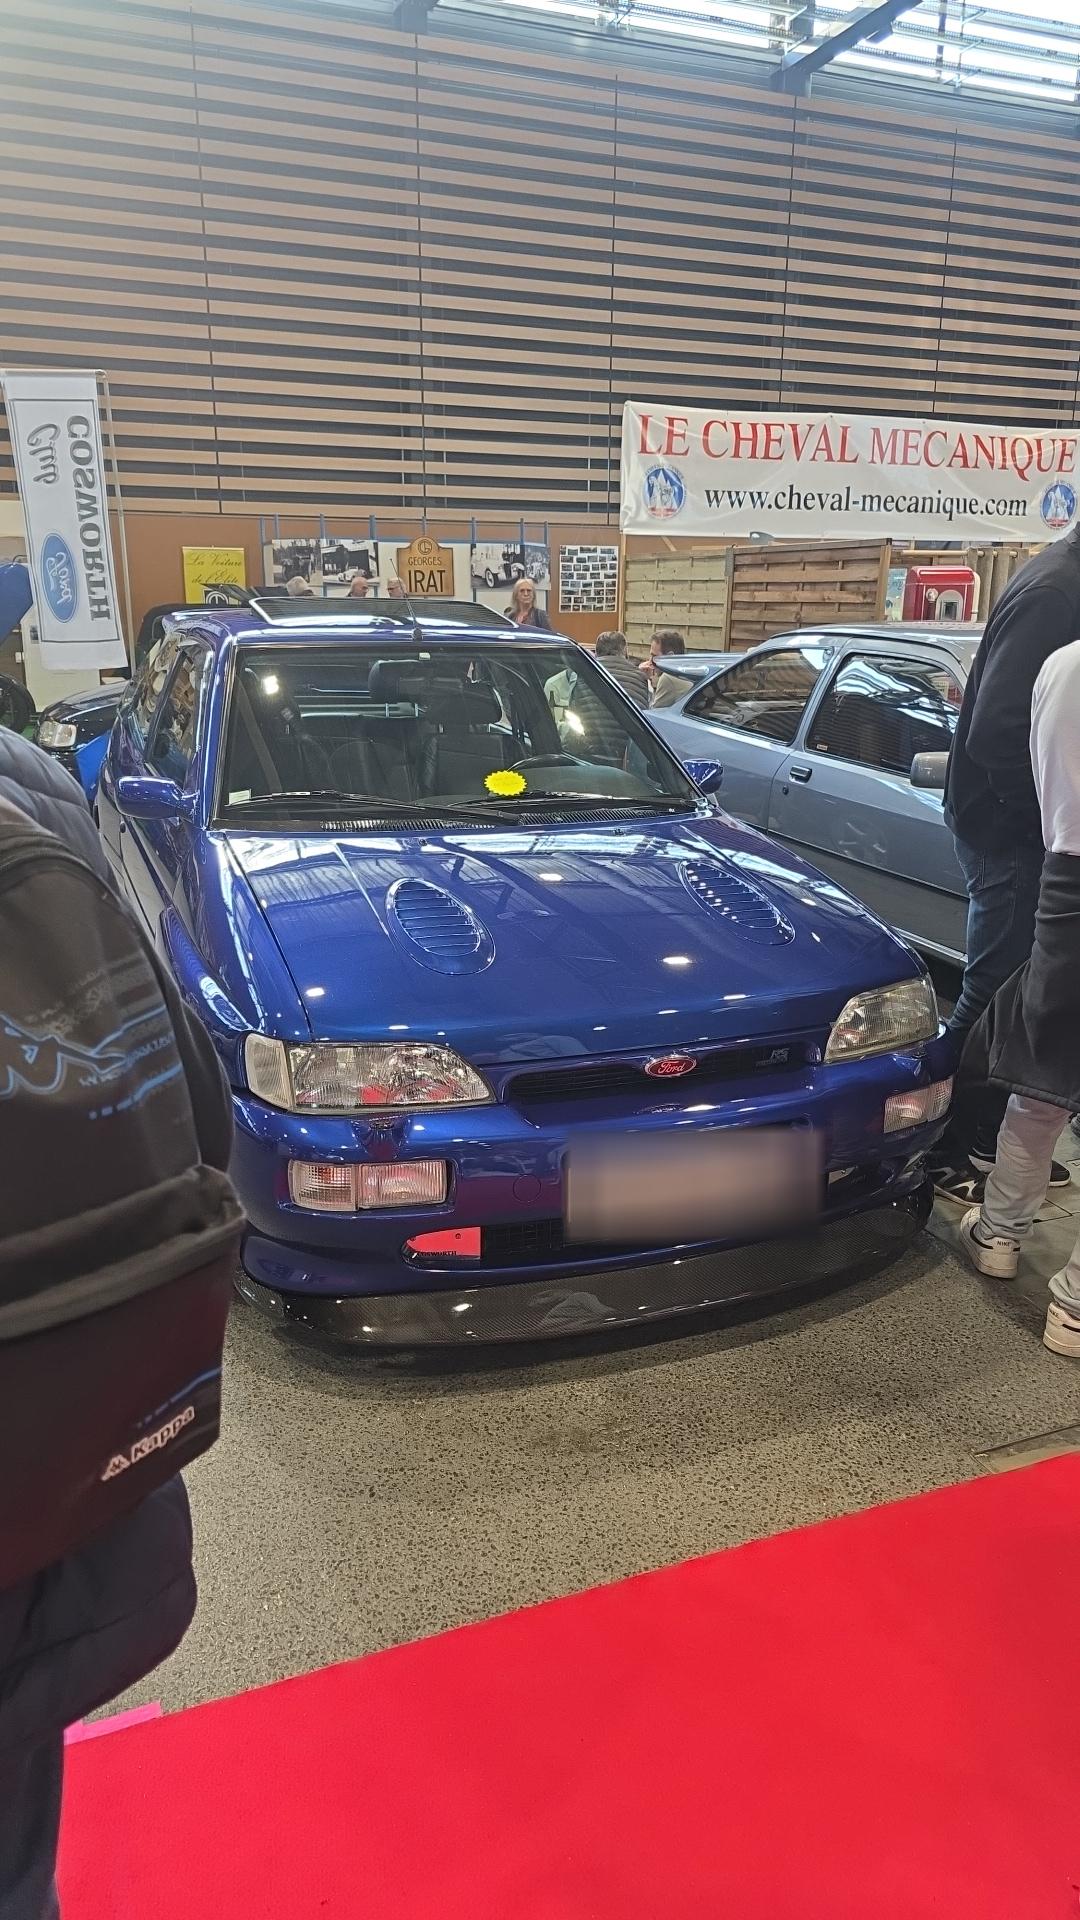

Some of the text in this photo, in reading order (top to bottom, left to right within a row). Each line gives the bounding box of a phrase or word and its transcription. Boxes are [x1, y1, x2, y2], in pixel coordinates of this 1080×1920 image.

[638, 415, 1078, 481] LE CHEVAL MECANIQUE
[704, 485, 1028, 521] www.cheval-mecanique.com
[408, 556, 442, 566] GEORGES
[408, 570, 446, 593] IRAT
[657, 1061, 686, 1074] Ford
[131, 1406, 195, 1463] Kappa
